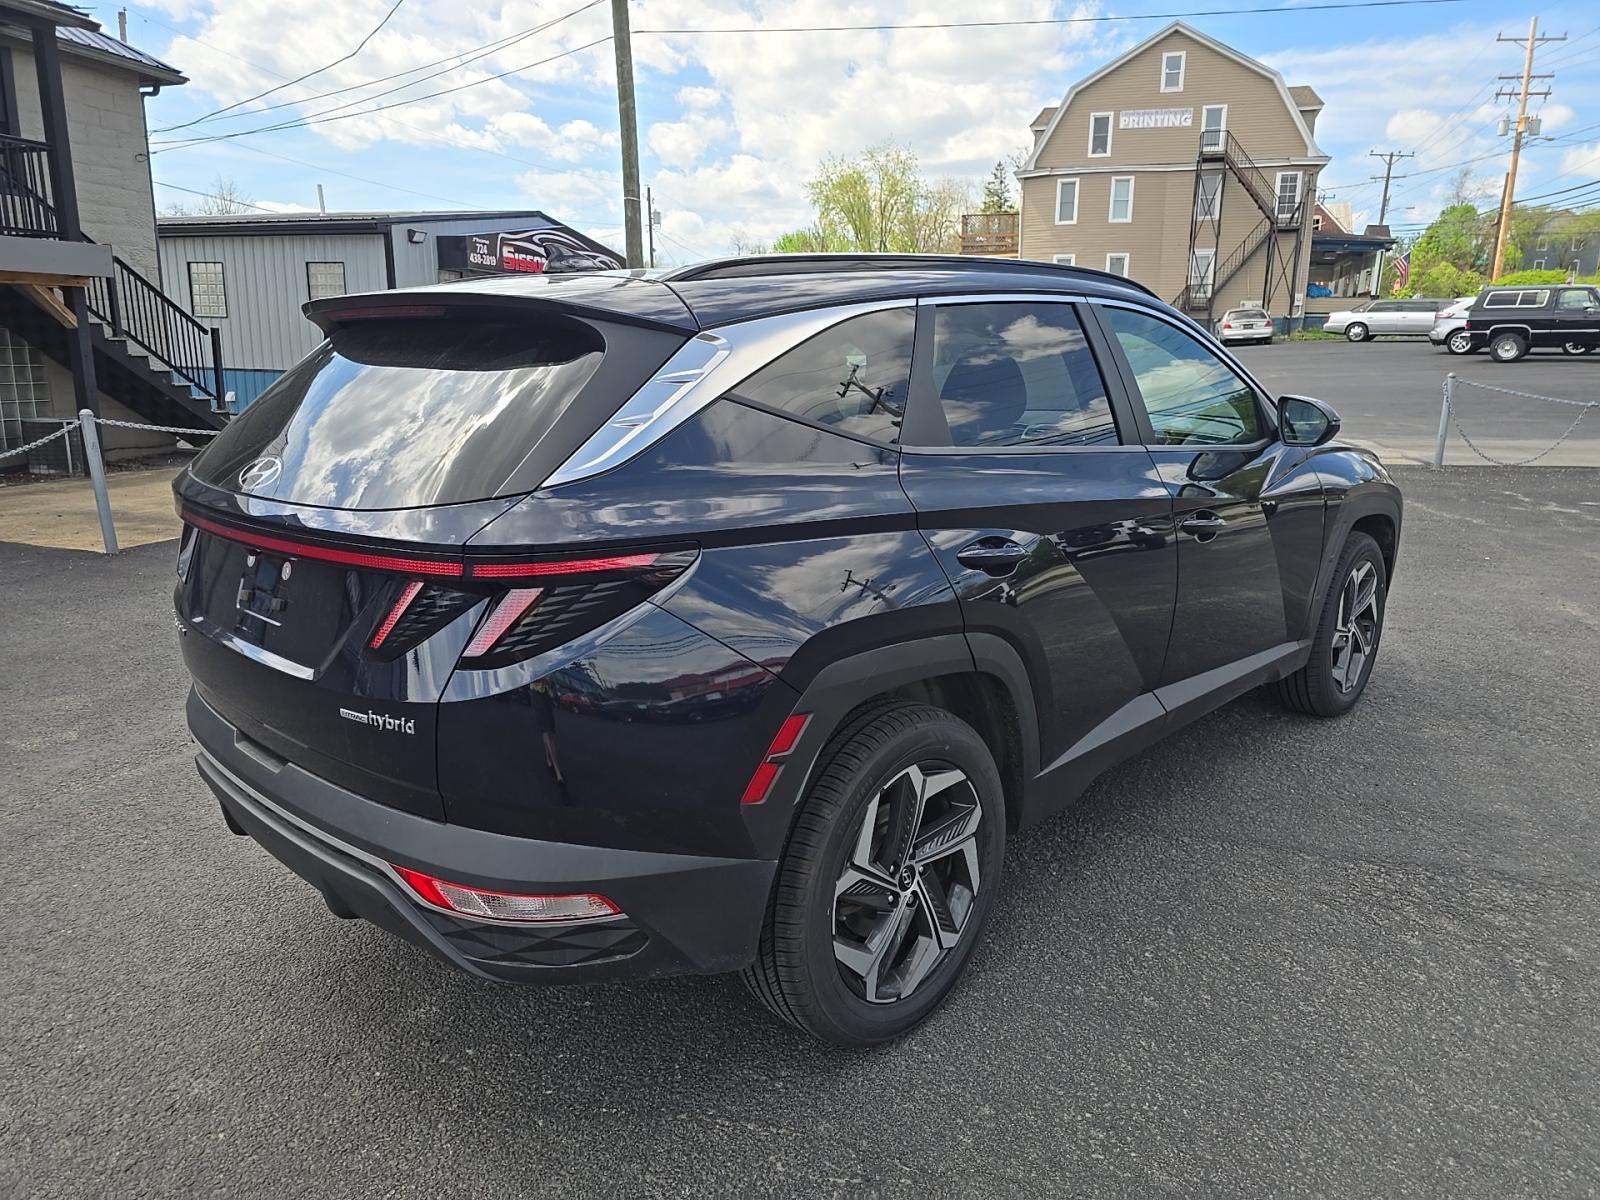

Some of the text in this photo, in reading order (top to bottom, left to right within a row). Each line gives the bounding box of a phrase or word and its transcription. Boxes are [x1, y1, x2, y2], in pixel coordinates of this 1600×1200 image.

[1120, 113, 1192, 128] PRINTING
[476, 243, 488, 254] 724
[368, 710, 415, 734] hybrid
